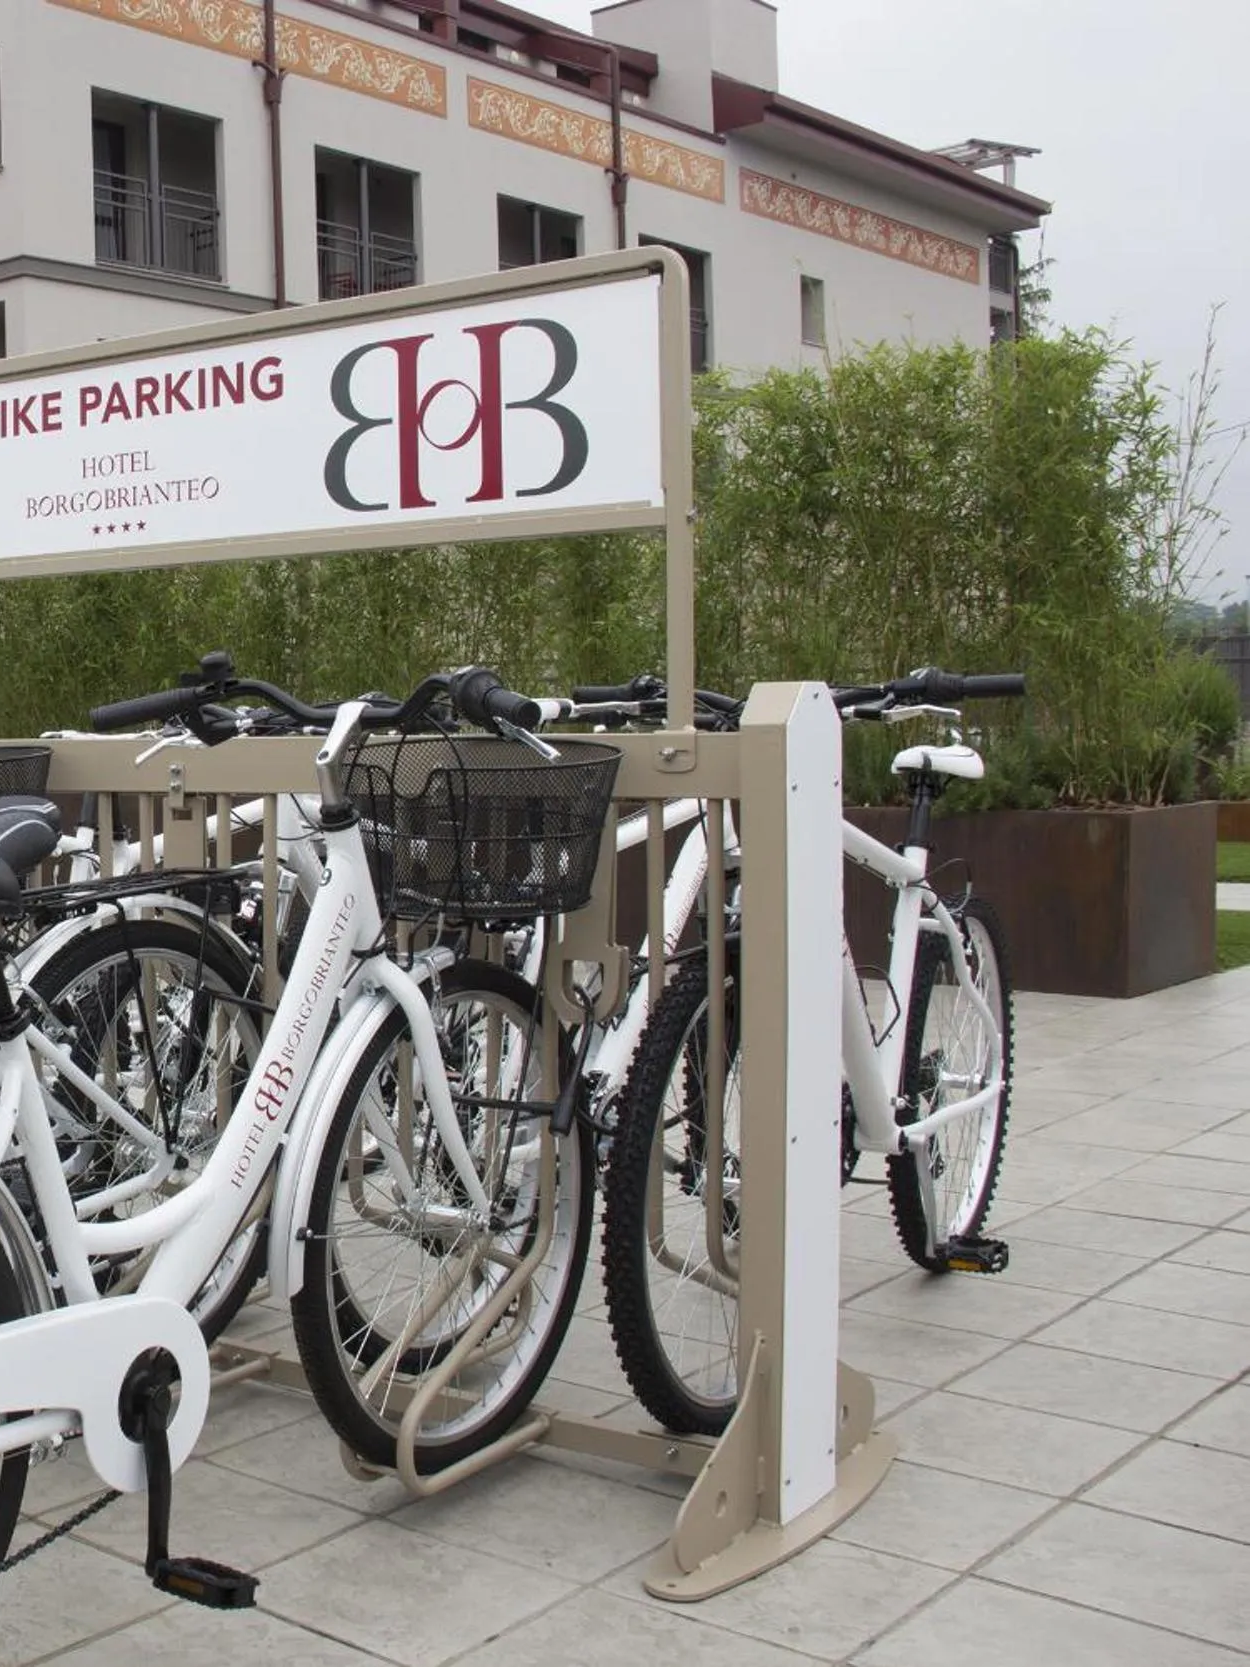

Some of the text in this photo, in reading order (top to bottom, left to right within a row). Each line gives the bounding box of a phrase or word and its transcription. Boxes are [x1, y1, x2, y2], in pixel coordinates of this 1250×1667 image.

[79, 356, 284, 427] PARKING
[81, 450, 156, 479] HOTEL
[26, 475, 220, 519] BORGOBRIANTEO
[230, 1122, 267, 1190] HOTEL
[281, 893, 355, 1065] BORGOBRIANTEO
